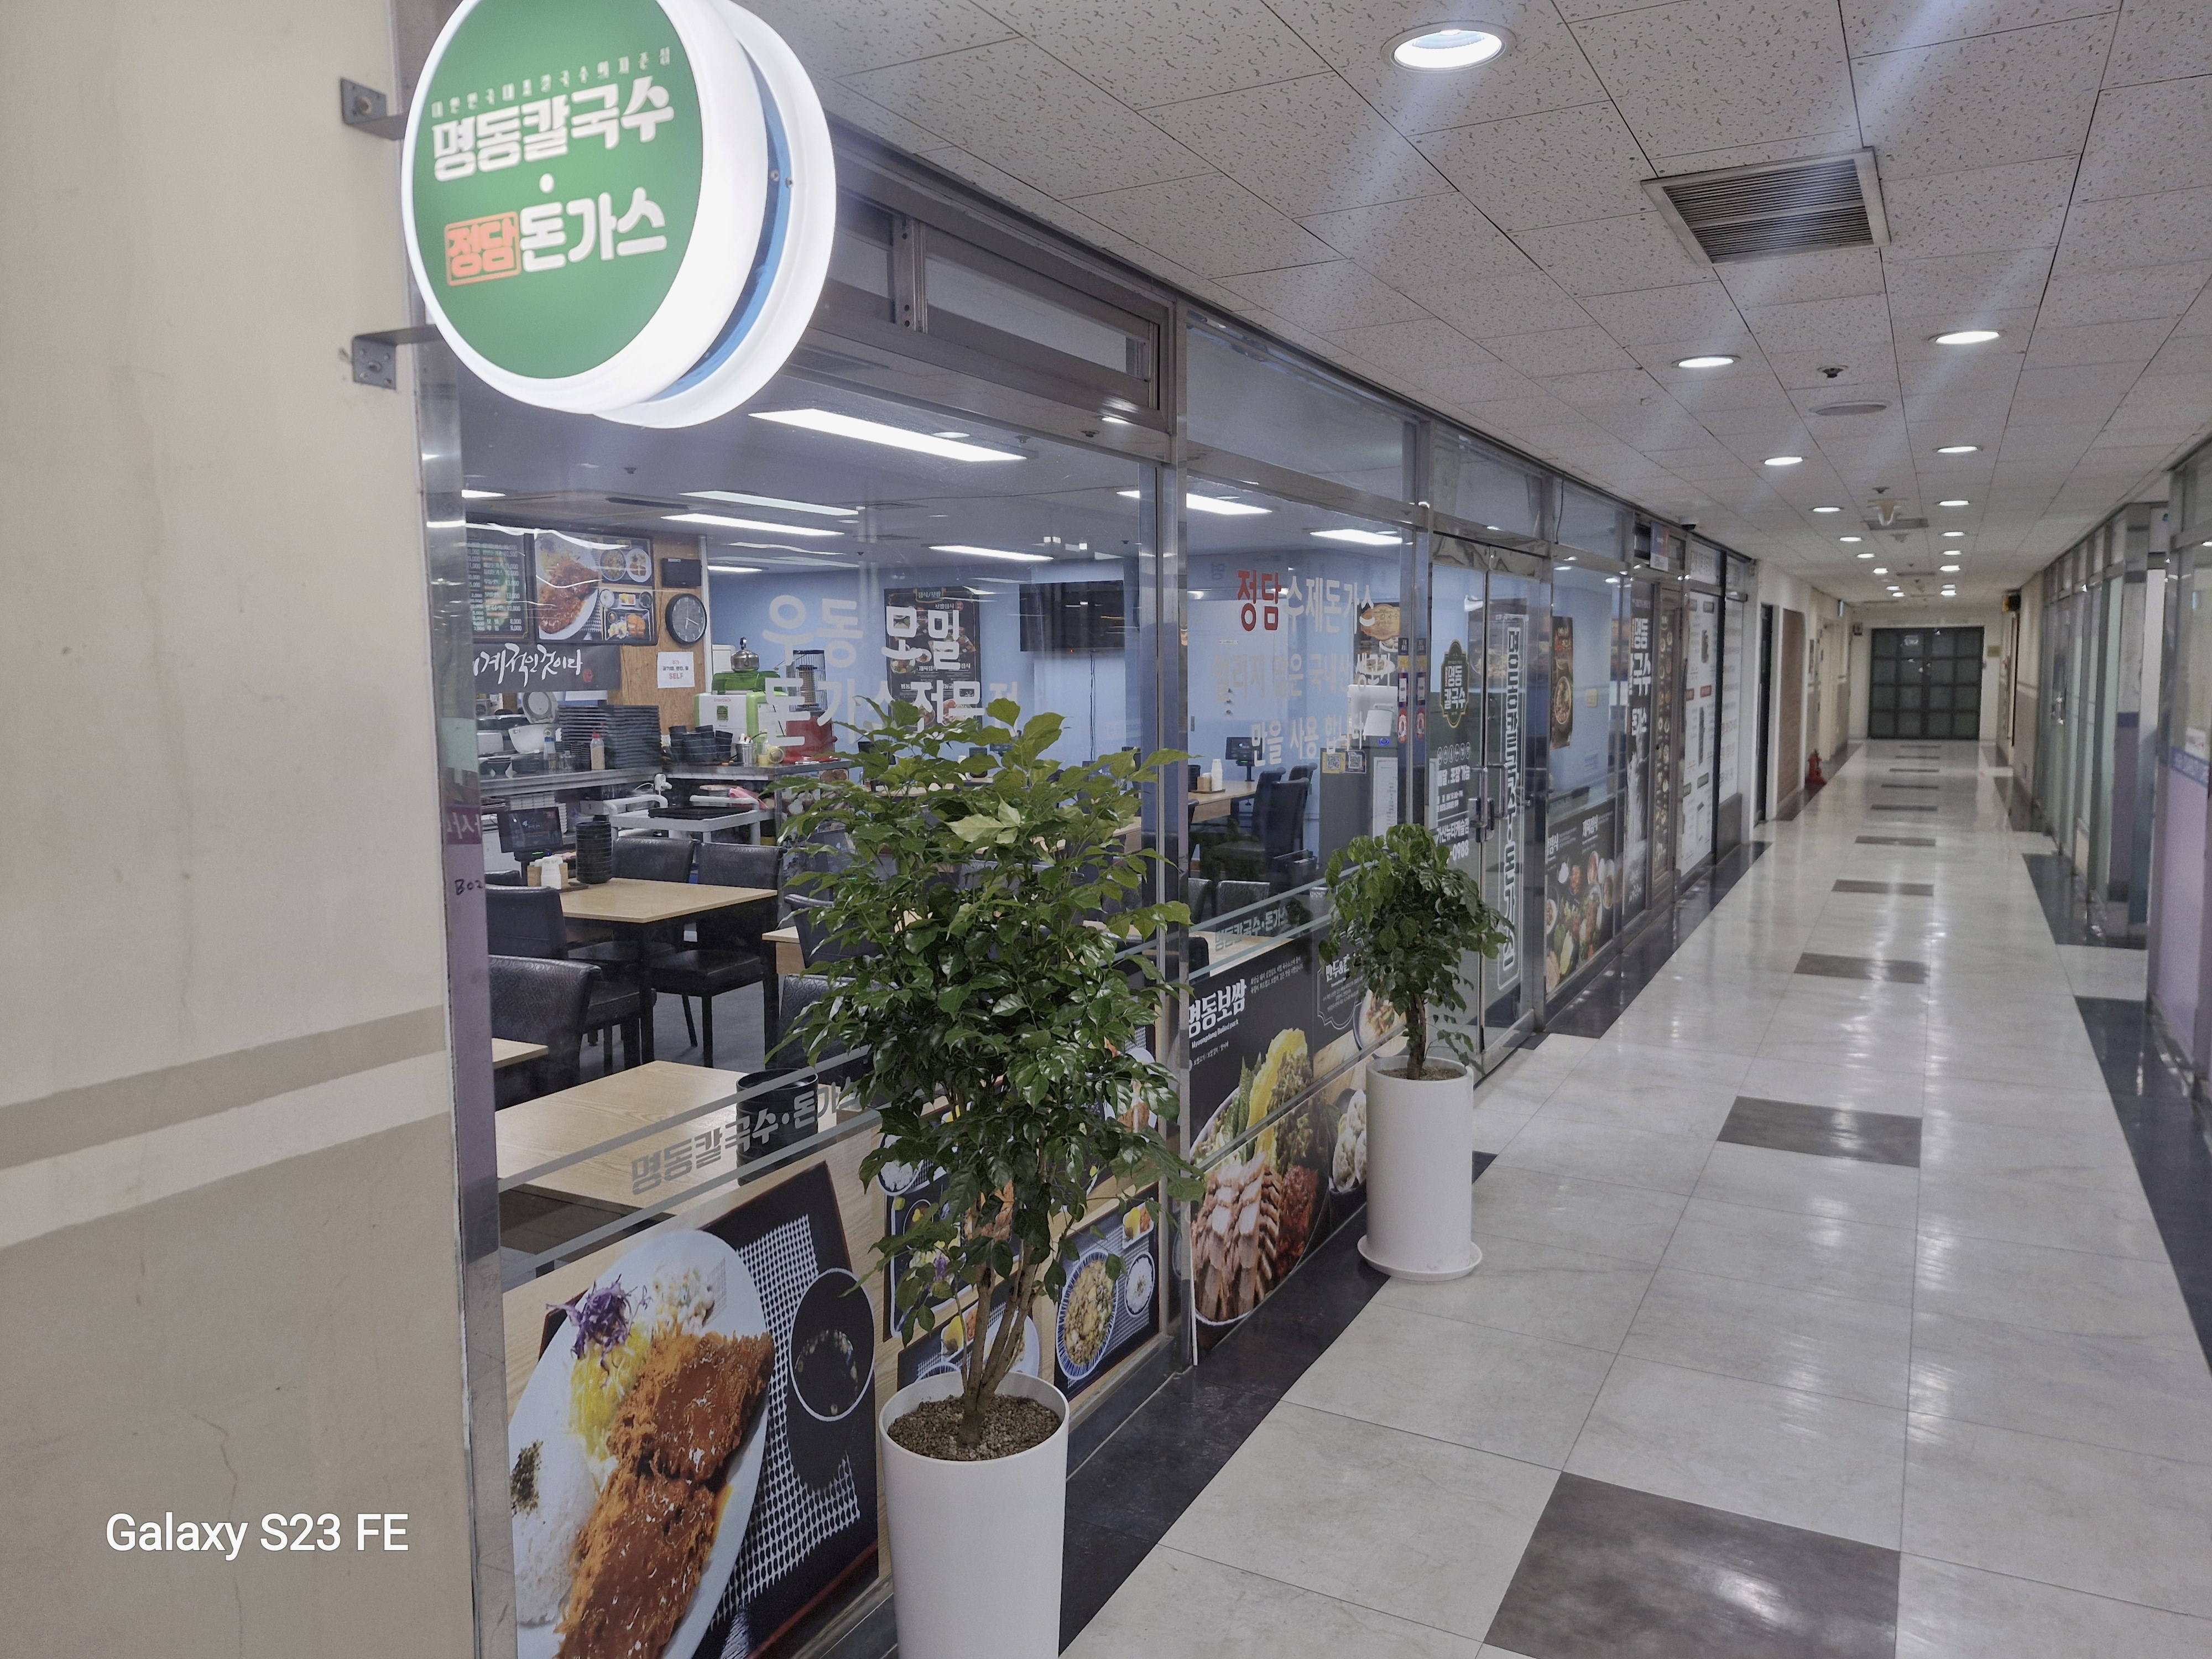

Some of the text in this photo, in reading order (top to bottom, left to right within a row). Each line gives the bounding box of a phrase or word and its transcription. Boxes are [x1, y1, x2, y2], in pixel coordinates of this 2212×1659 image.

[432, 75, 675, 182] 명동칼국수
[520, 186, 667, 272] 돈가스
[763, 594, 961, 670] 우동 모밀
[1444, 687, 1465, 709] 칼국수
[1448, 665, 1462, 687] 명동
[1188, 978, 1247, 1039] 명동보쌈
